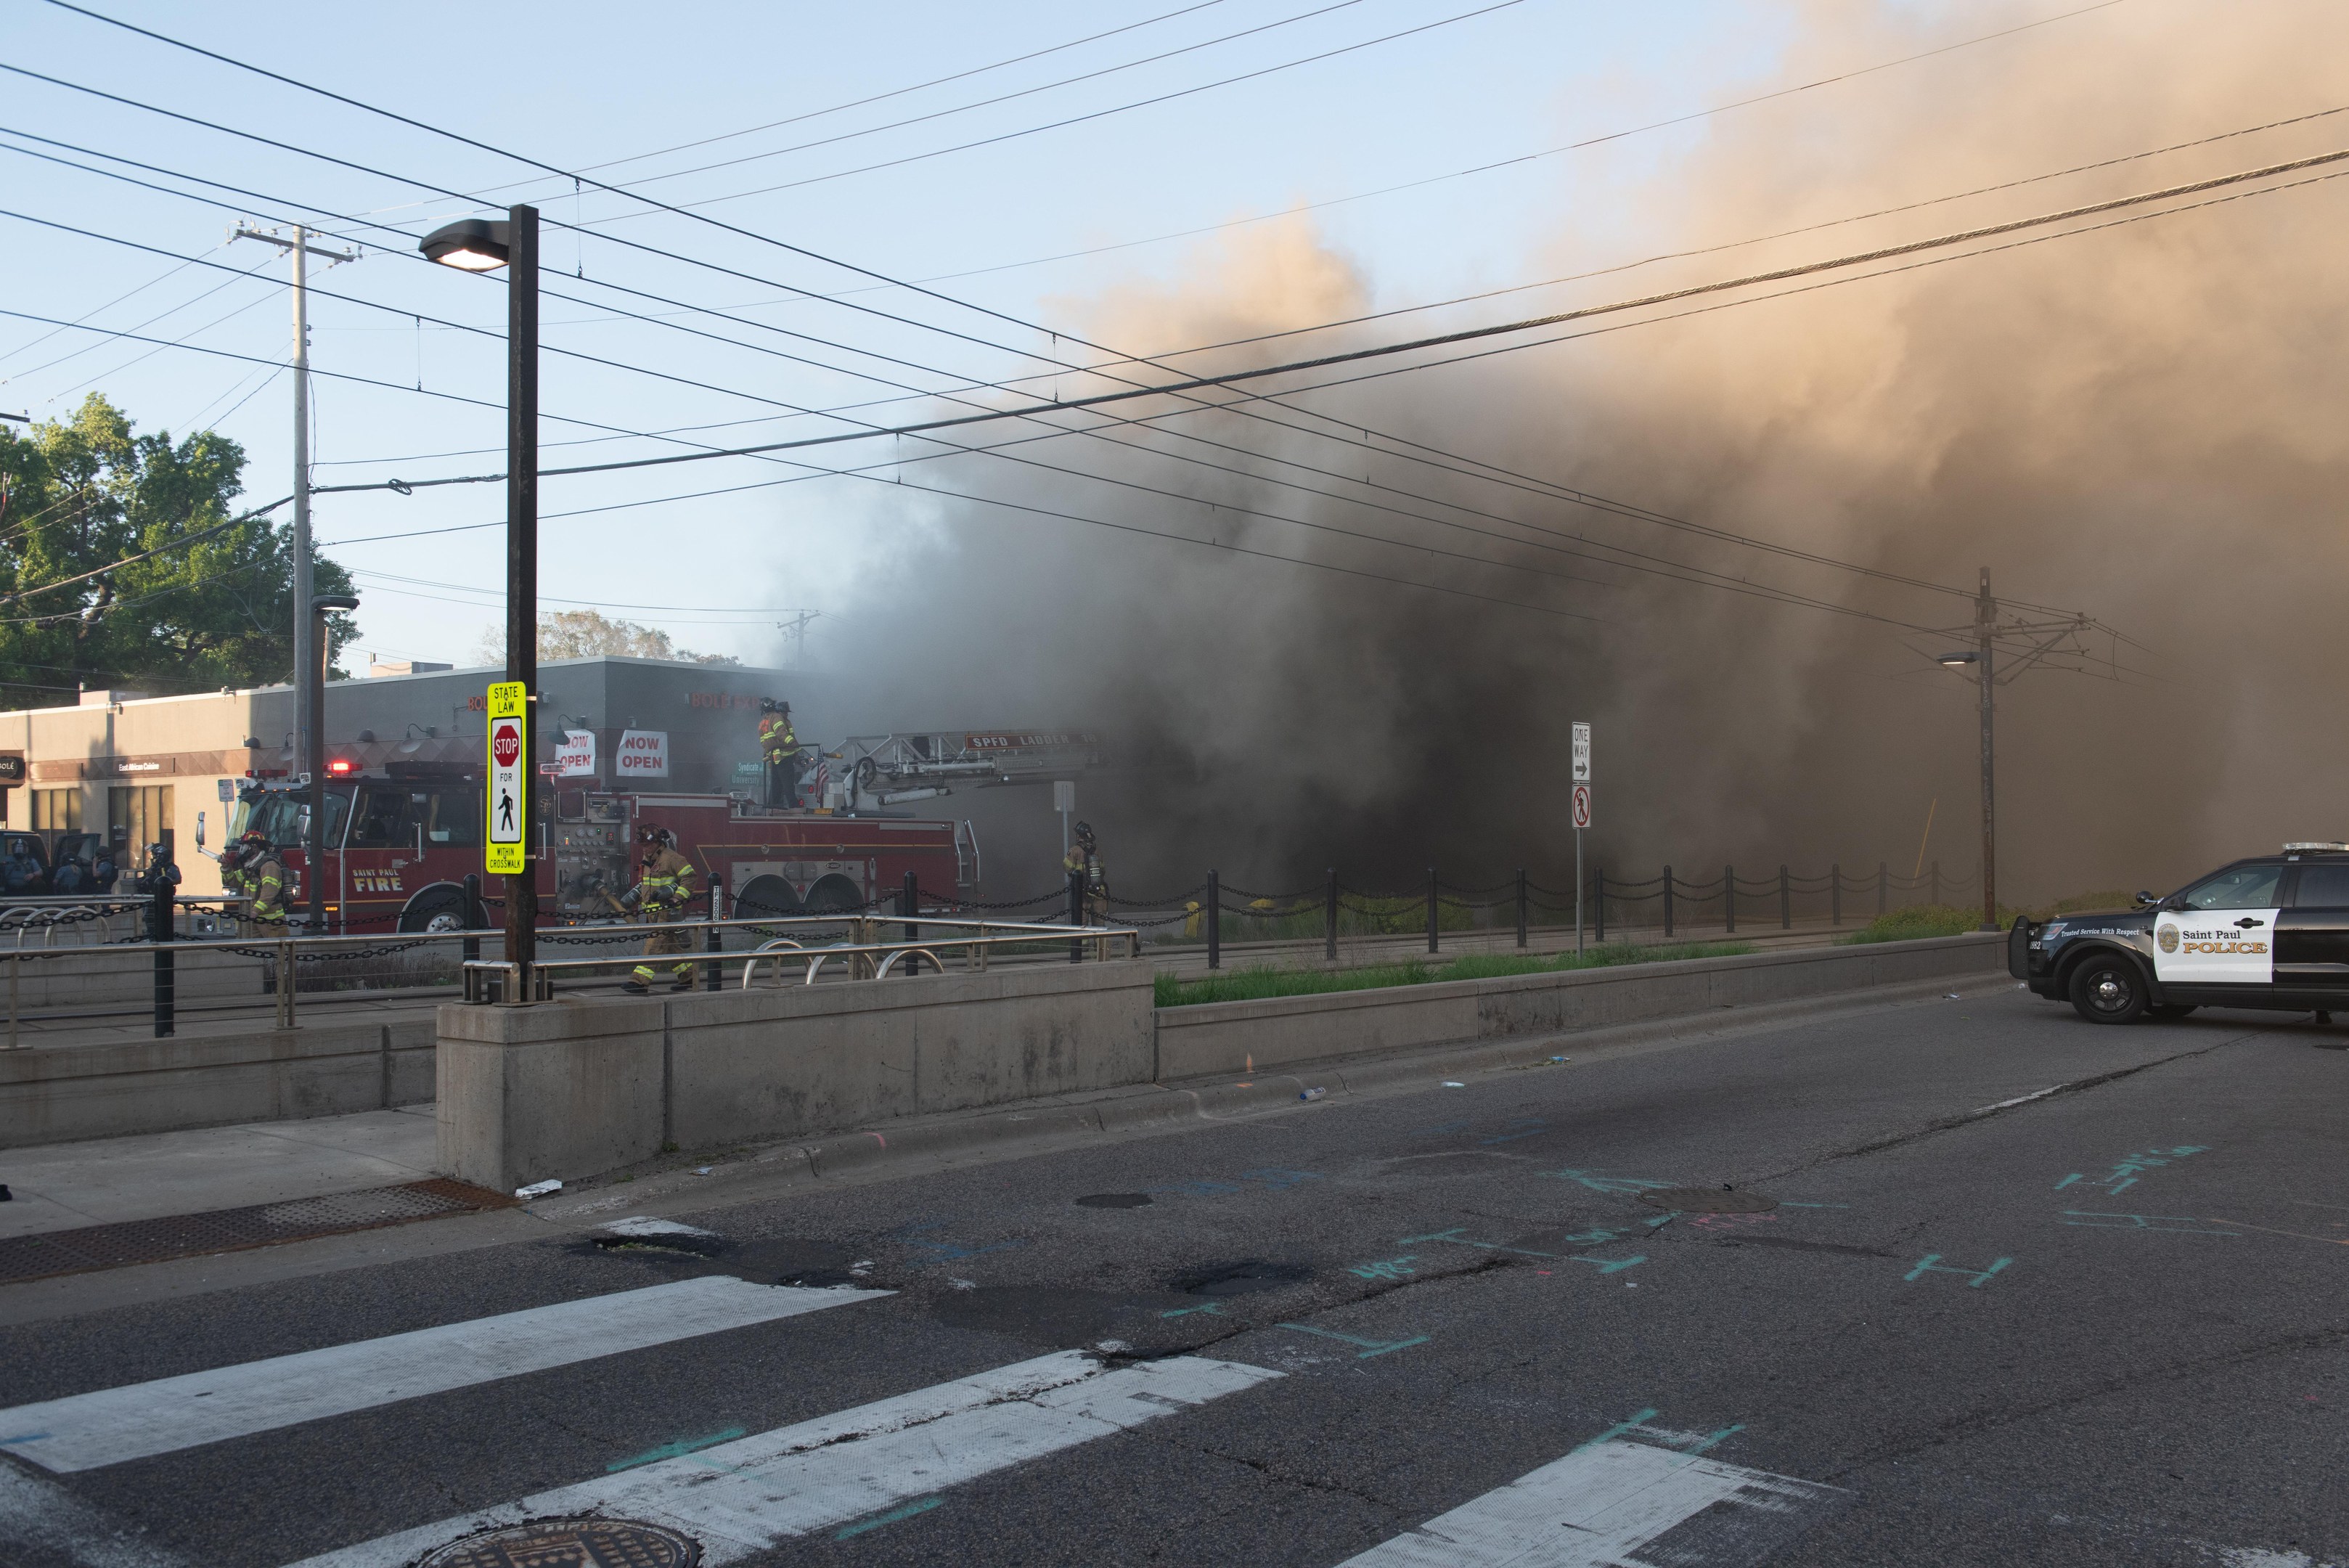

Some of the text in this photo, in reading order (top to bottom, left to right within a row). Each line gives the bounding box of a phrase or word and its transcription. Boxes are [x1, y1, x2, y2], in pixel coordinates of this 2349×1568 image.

[494, 686, 518, 699] STATE
[468, 695, 488, 710] BOL
[498, 701, 515, 713] LAW
[973, 737, 1008, 748] SPFD
[1020, 735, 1070, 746] LADDER
[1574, 728, 1588, 742] ONE
[495, 738, 518, 754] STOP
[563, 736, 589, 749] NOW
[625, 737, 660, 749] NOW
[1574, 745, 1588, 758] WAY
[560, 754, 591, 767] OPEN
[622, 756, 662, 769] OPEN
[738, 762, 759, 773] Syndicate
[500, 773, 512, 782] FOR
[732, 775, 760, 786] University
[497, 847, 515, 856] WITHIN
[489, 859, 520, 868] CROSSWALK
[354, 877, 404, 892] FIRE
[2183, 931, 2241, 939] Saint Paul
[2183, 942, 2268, 954] POLICE
